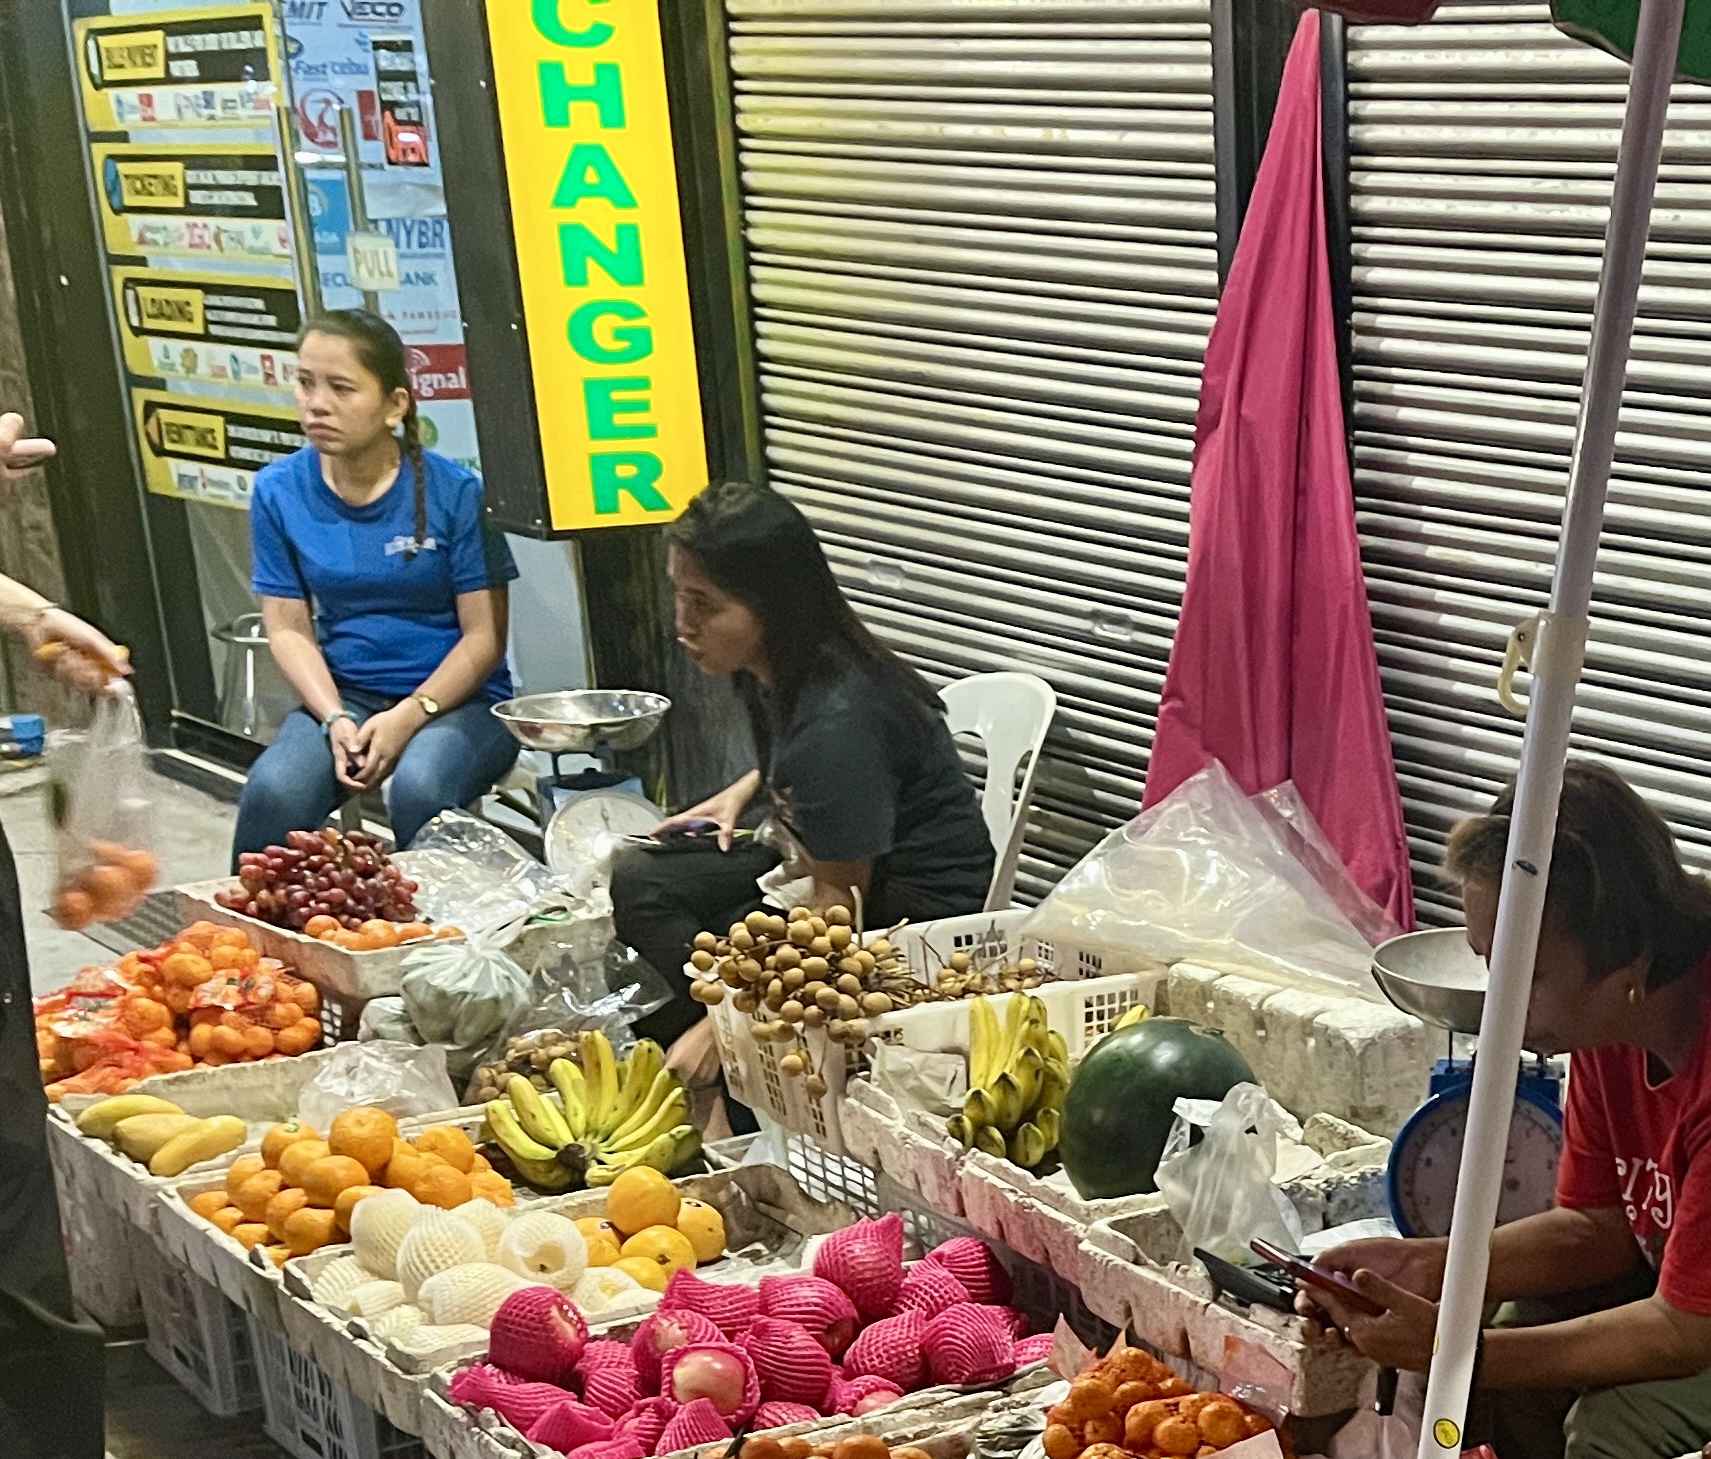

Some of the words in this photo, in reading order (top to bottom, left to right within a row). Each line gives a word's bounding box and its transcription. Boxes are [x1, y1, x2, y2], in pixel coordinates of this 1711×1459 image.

[283, 1, 327, 18] MIT
[340, 0, 405, 21] VECO
[353, 248, 395, 279] PULL
[530, 0, 674, 515] CHANGER
[400, 272, 439, 285] ANK
[406, 367, 467, 397] ignal
